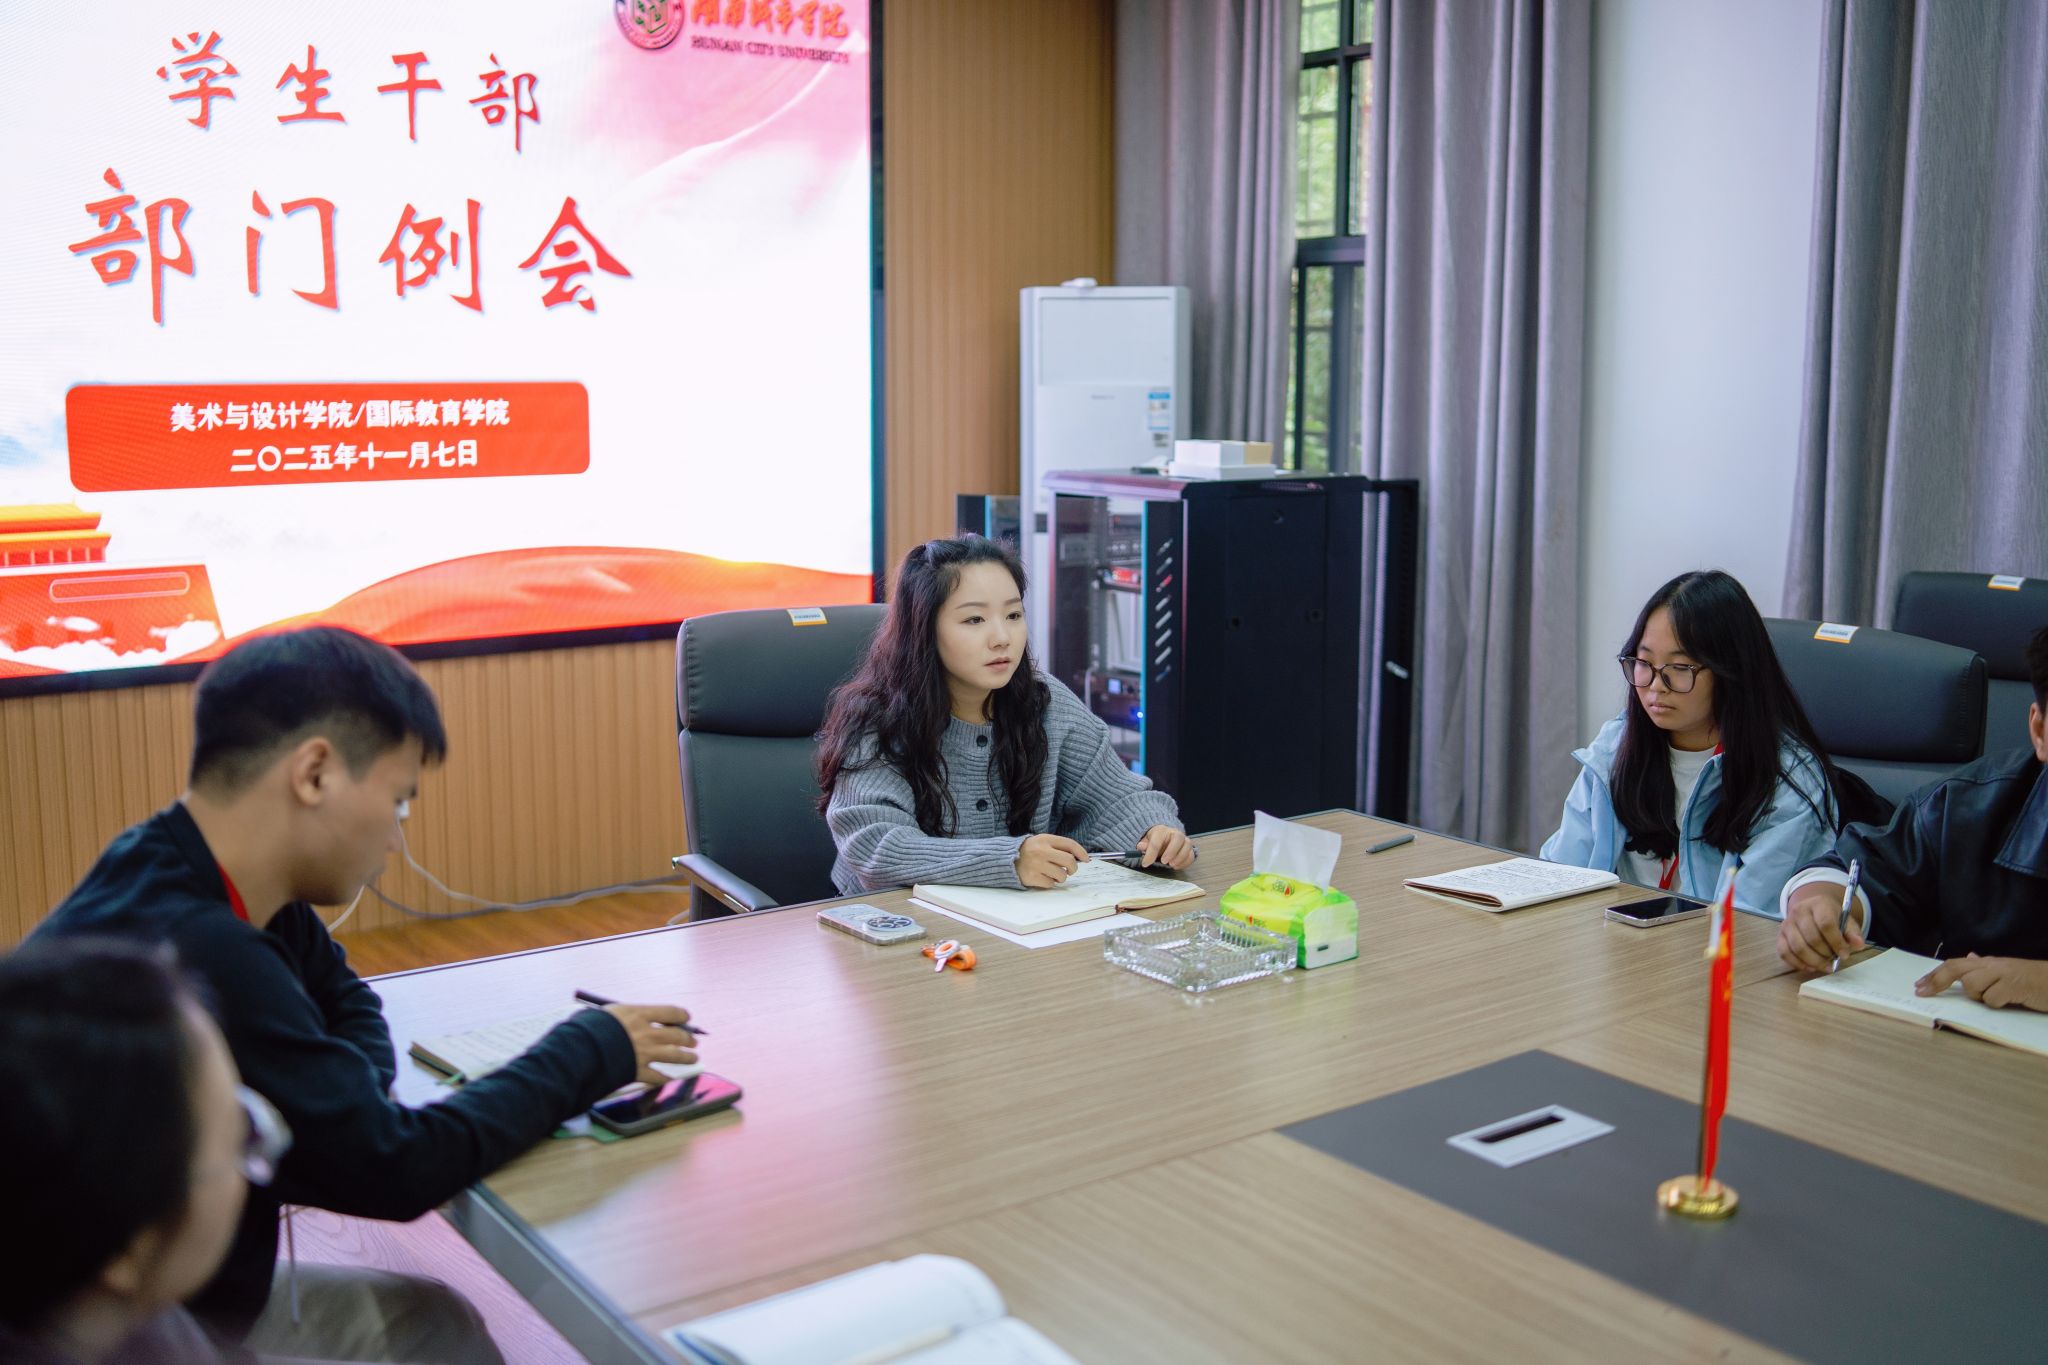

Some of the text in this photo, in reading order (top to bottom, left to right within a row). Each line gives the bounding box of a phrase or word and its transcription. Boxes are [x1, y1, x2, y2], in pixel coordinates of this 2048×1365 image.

[156, 31, 541, 151] 学生干部
[67, 167, 632, 326] 部门例会
[170, 398, 510, 432] 美术与设计学院/国际教育学院
